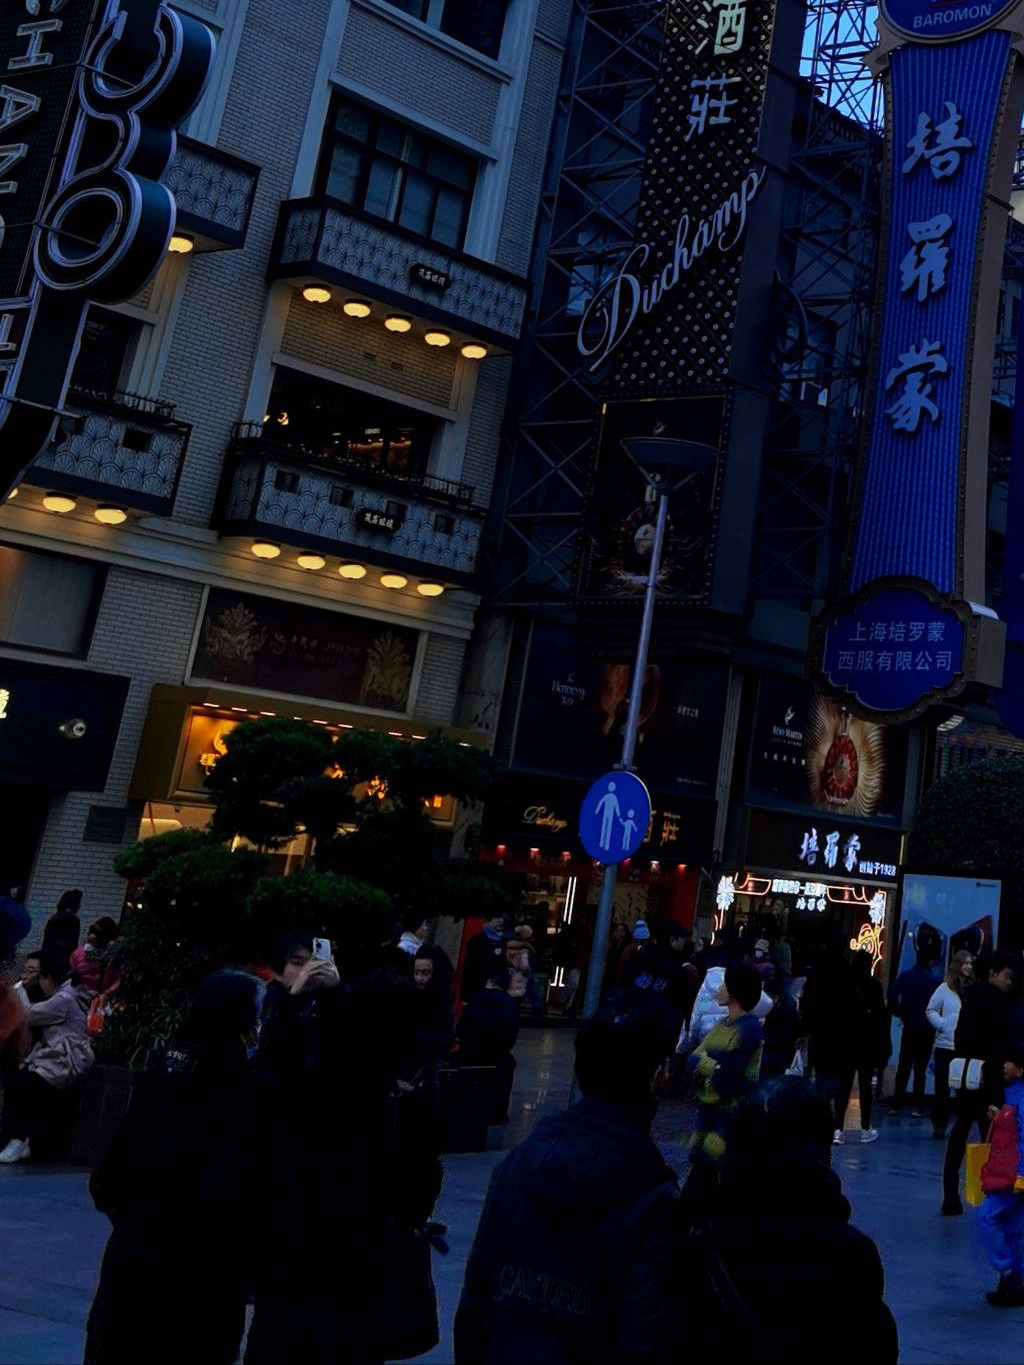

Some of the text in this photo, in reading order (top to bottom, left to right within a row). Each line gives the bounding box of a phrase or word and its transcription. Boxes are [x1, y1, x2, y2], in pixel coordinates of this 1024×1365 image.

[913, 4, 992, 29] BAROMON
[577, 165, 766, 372] Duchamp
[849, 621, 946, 642] 上海培罗蒙
[838, 650, 952, 671] 西服有限公司
